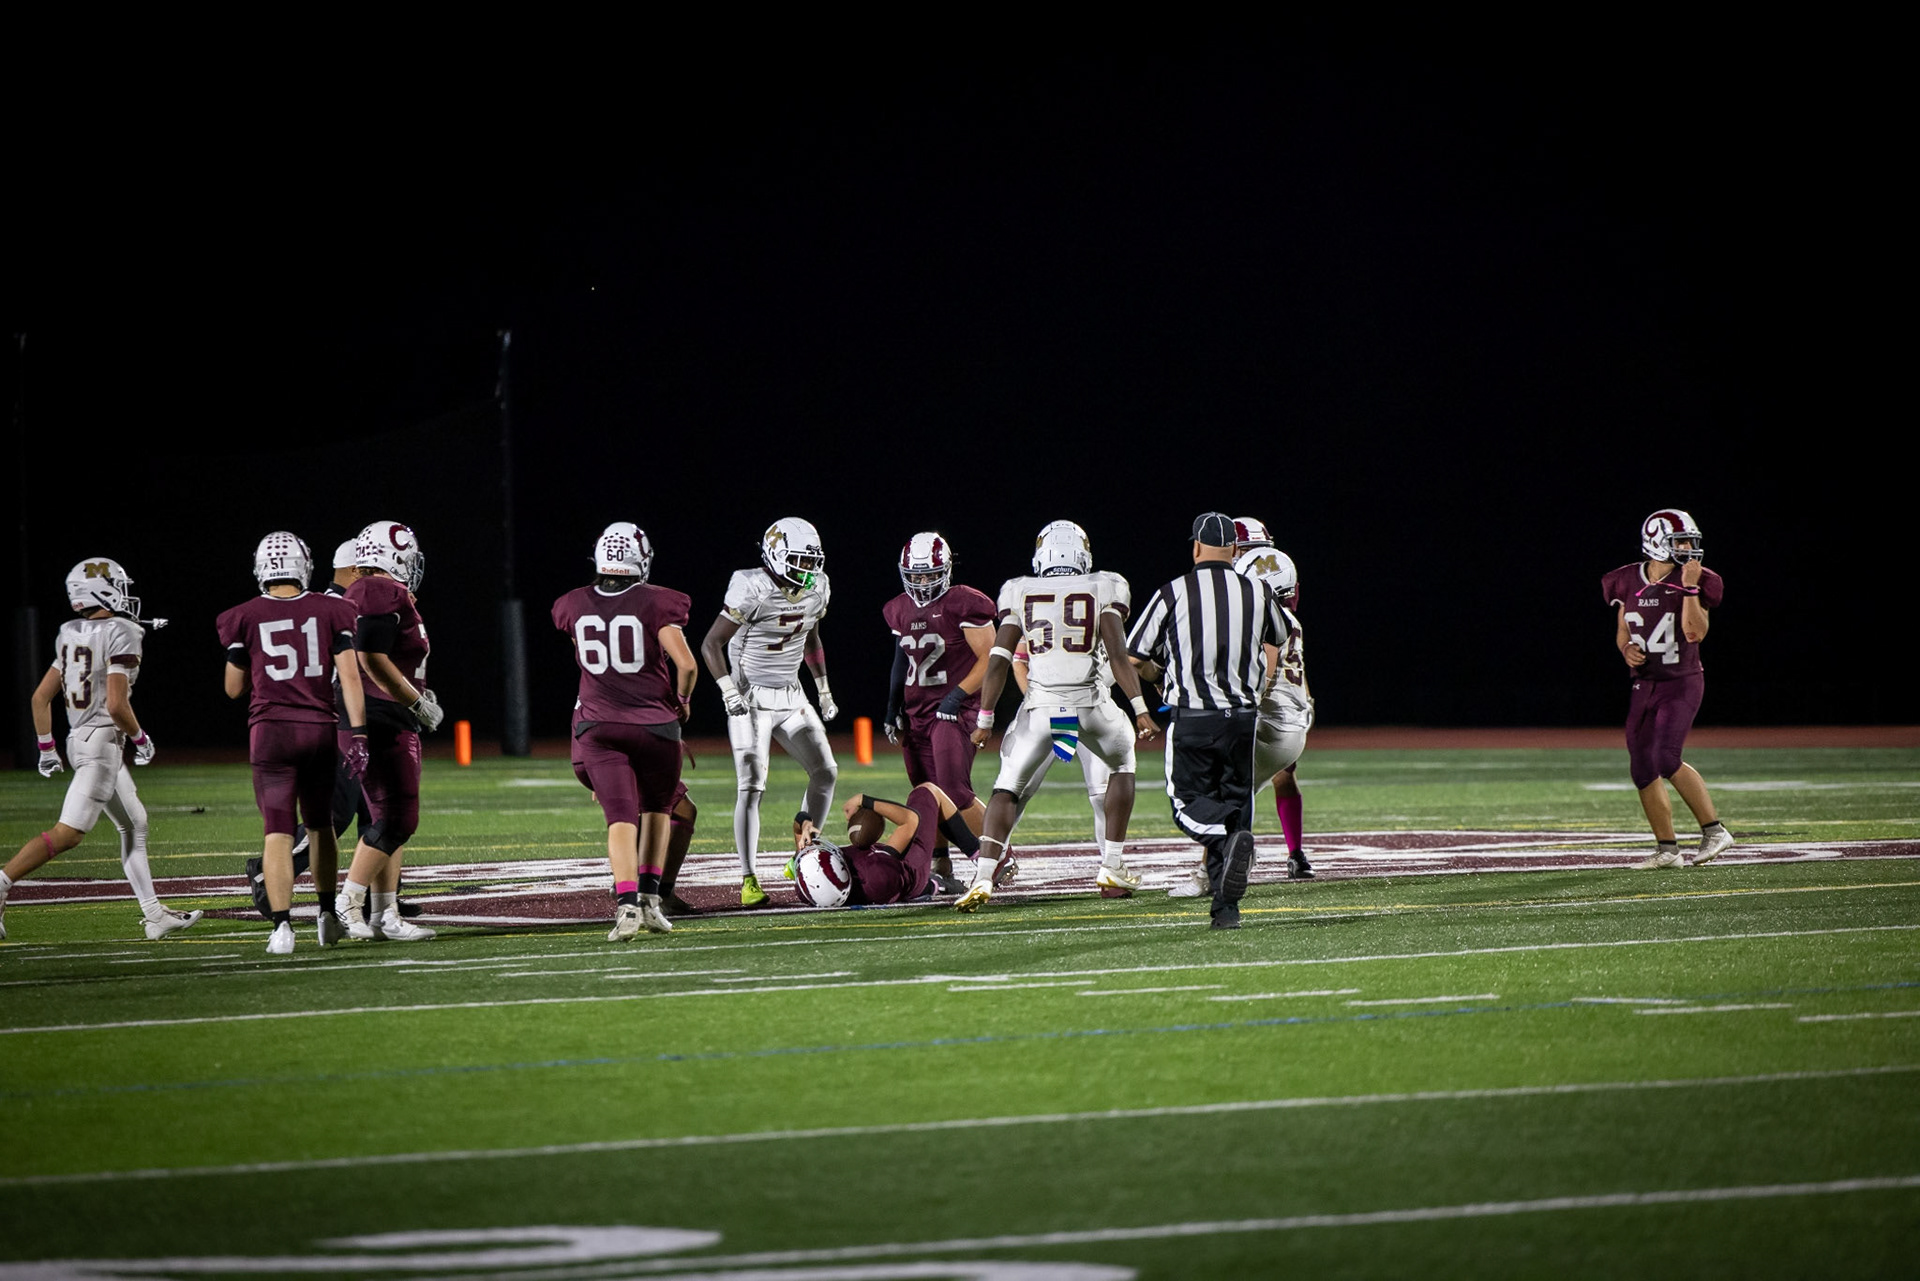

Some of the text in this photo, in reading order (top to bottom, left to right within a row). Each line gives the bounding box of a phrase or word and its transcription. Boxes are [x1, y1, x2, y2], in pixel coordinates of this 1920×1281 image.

[84, 562, 111, 579] M
[270, 557, 284, 570] 51
[602, 567, 630, 575] Riddell
[1254, 554, 1280, 576] M
[1638, 599, 1659, 607] RAMS
[767, 613, 804, 651] 7
[1024, 593, 1096, 656] 59
[258, 617, 323, 681] 51
[575, 615, 645, 675] 60
[61, 645, 93, 709] 13
[1224, 708, 1232, 718] S
